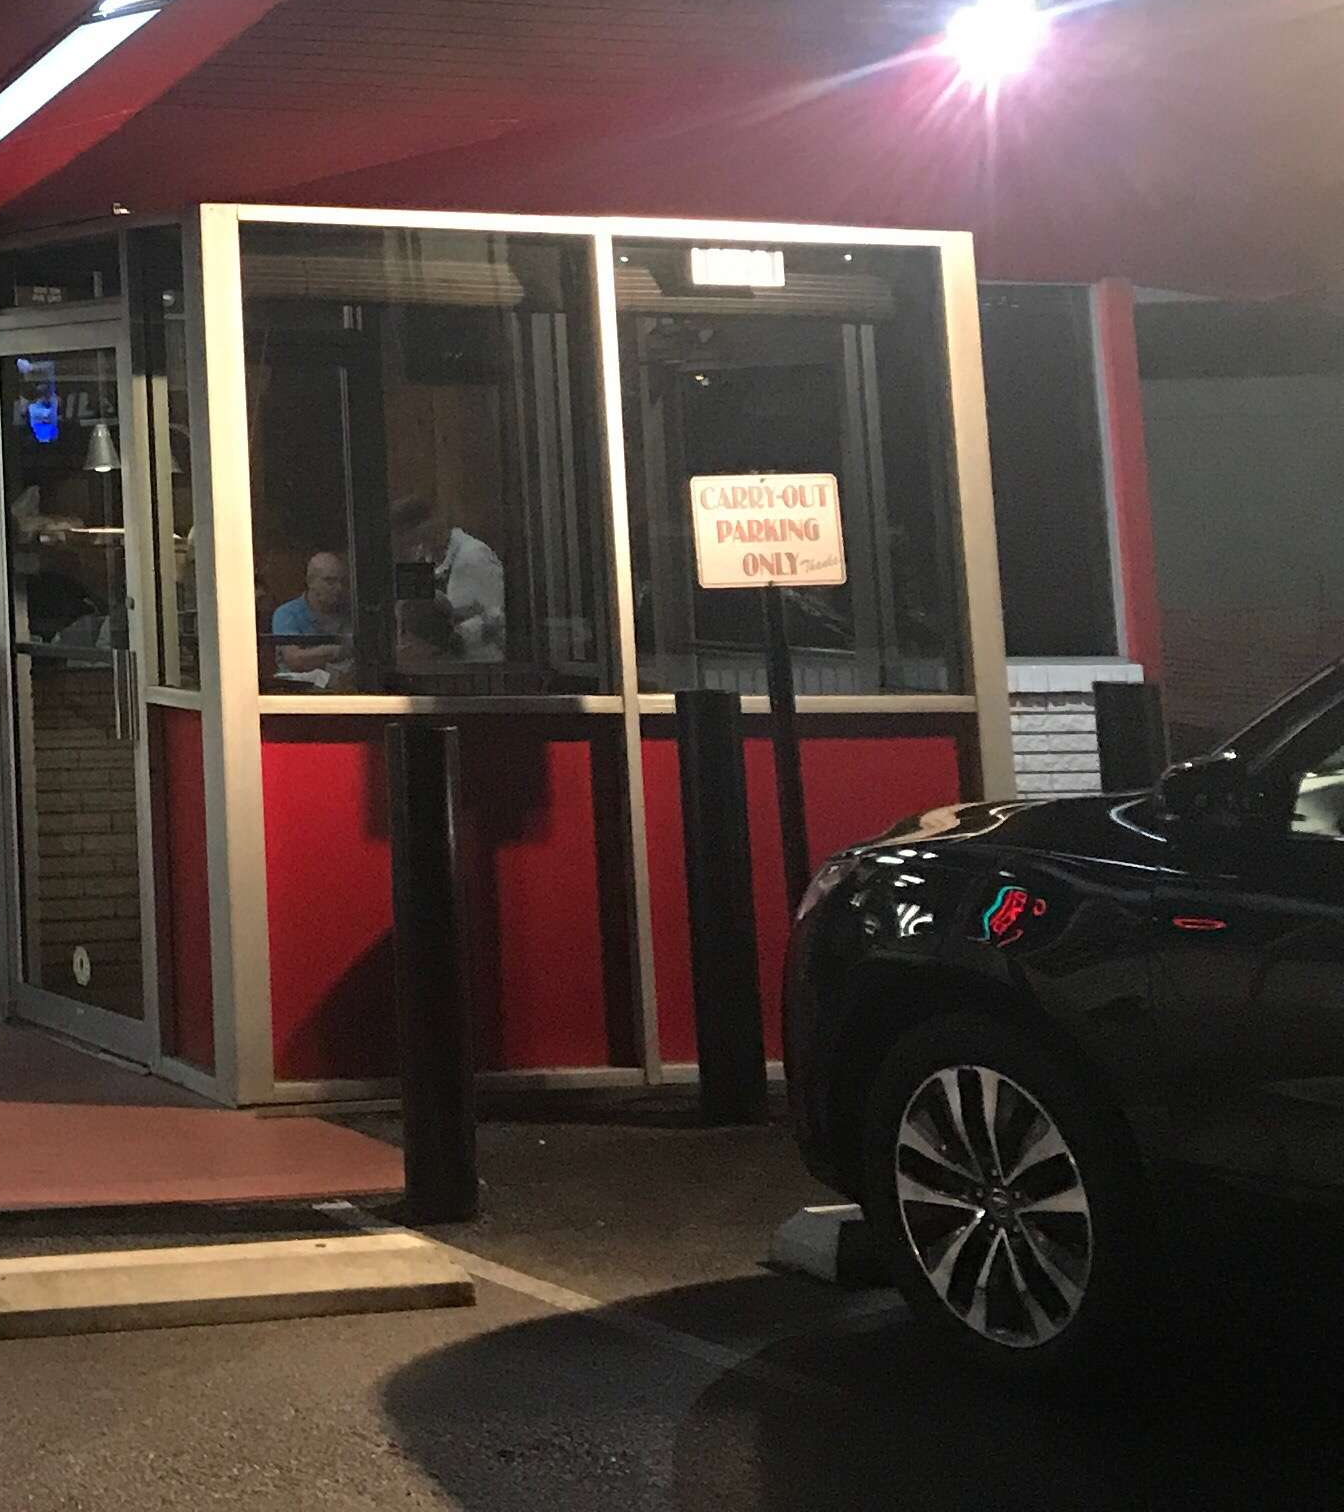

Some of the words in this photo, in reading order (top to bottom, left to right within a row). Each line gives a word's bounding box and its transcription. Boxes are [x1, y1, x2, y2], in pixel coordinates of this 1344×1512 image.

[700, 483, 833, 511] CARRY-OUT
[716, 517, 821, 544] PARKING
[742, 551, 799, 577] ONLY
